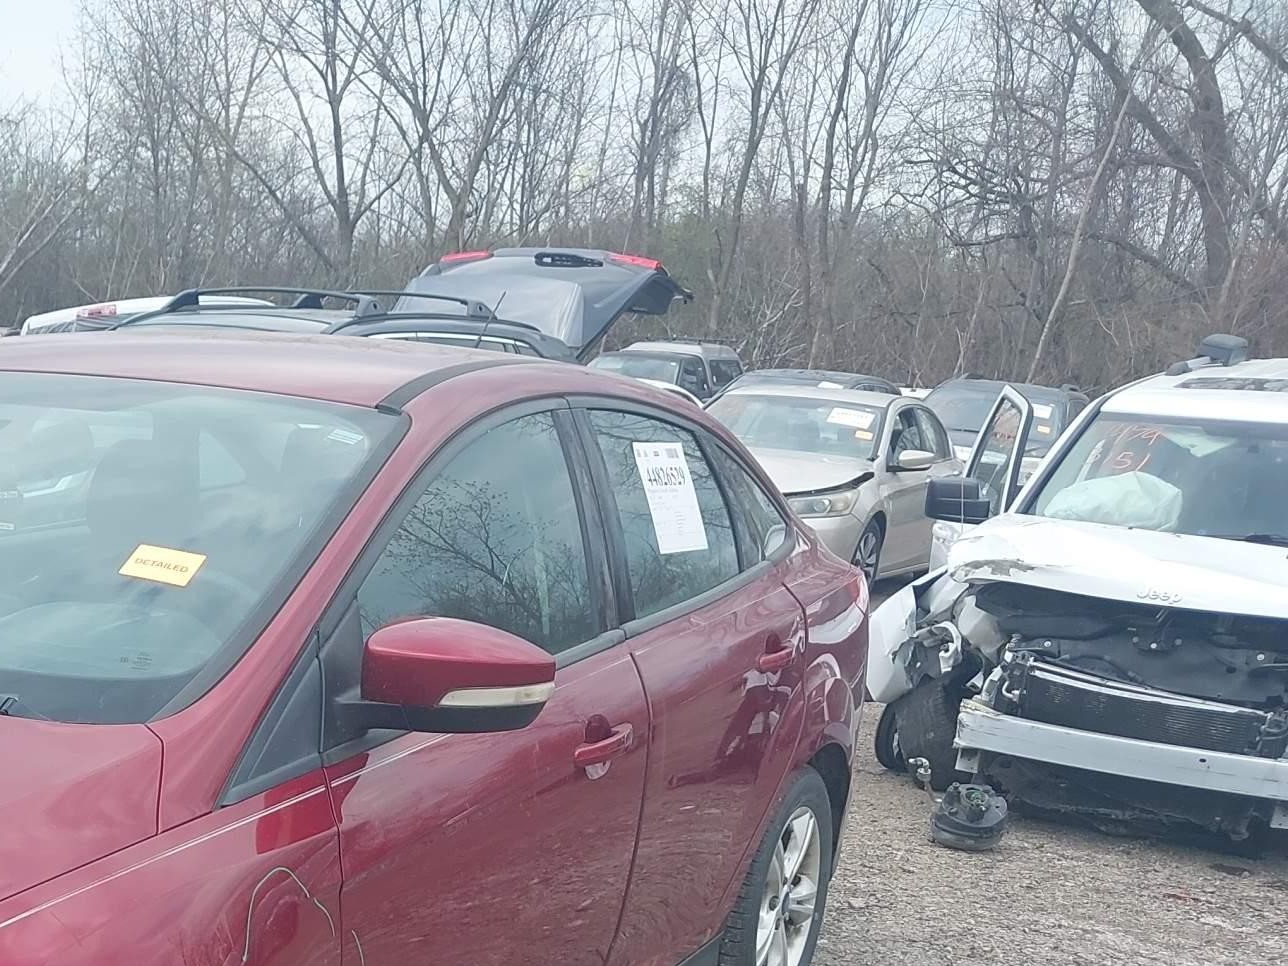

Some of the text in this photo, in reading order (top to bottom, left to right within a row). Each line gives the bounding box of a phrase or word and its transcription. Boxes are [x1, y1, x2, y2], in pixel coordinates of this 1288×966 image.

[647, 465, 686, 486] 44826529
[134, 557, 190, 574] DETAILED
[1136, 584, 1183, 605] Jeep
